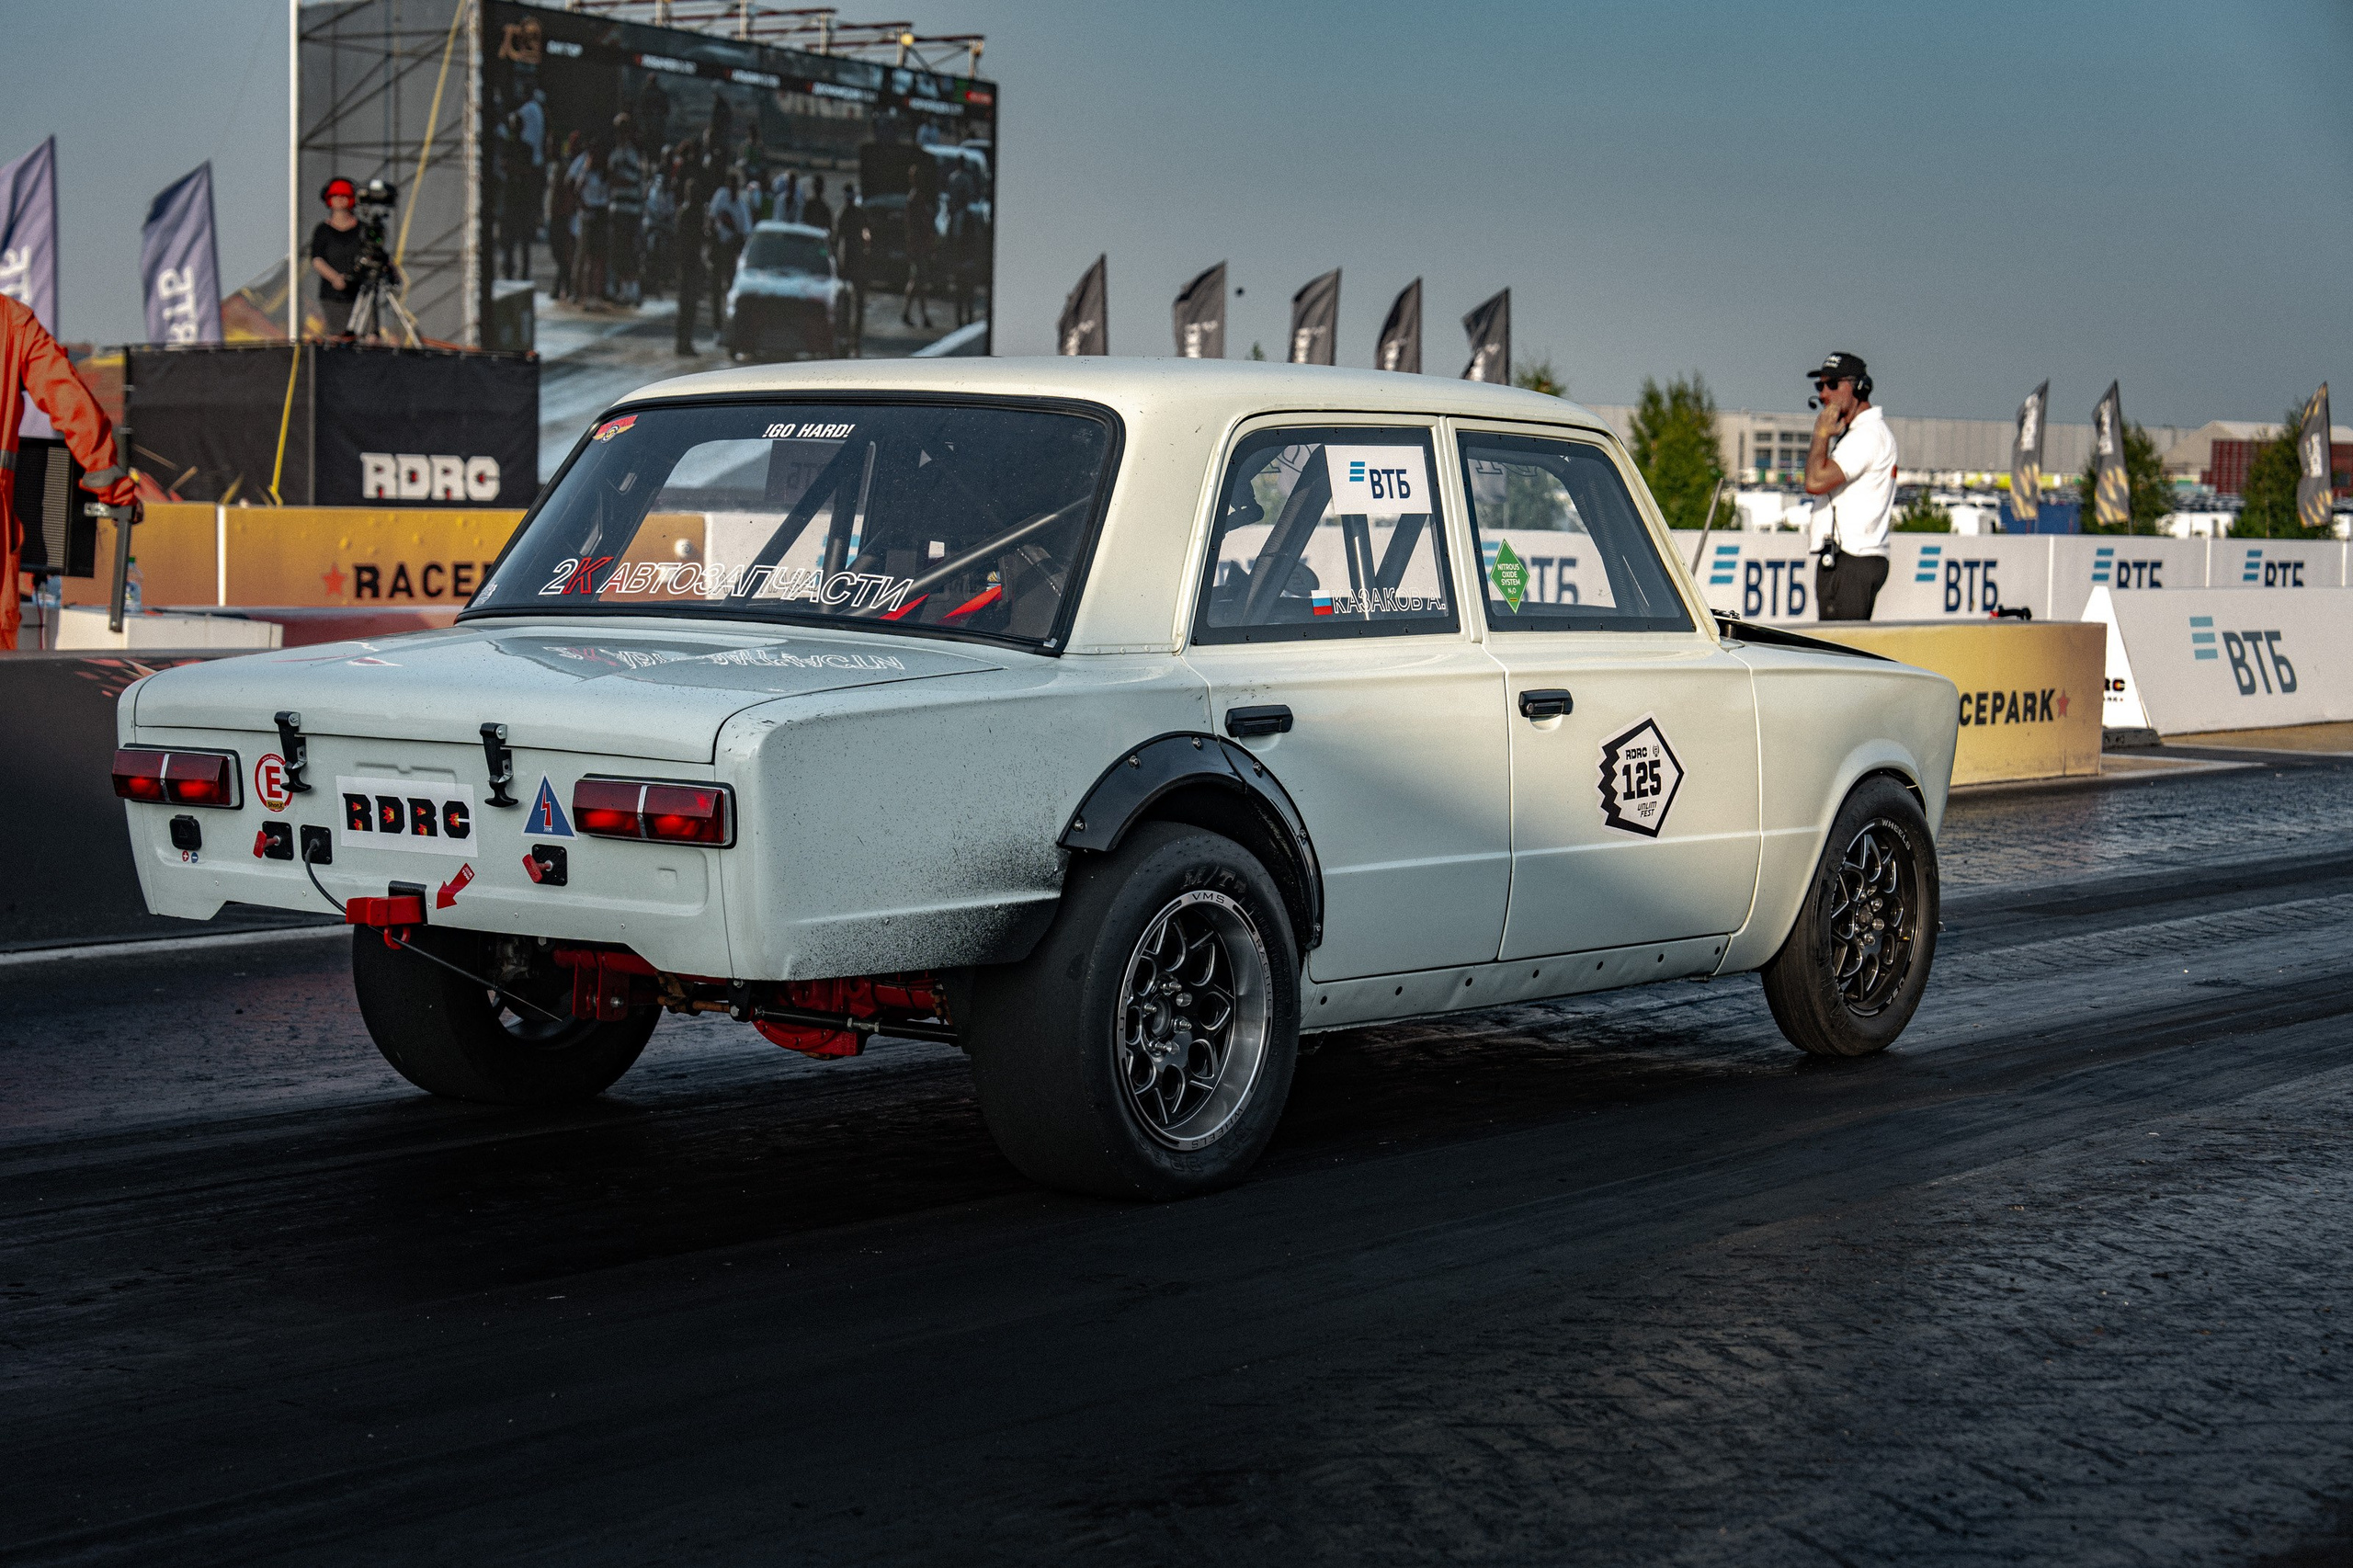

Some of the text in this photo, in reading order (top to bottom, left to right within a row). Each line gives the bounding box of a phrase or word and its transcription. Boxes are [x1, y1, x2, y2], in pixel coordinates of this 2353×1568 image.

[796, 423, 857, 438] HARD!
[359, 451, 501, 502] RDRC
[1368, 468, 1411, 499] ВТБ
[353, 562, 494, 599] RACE
[596, 561, 915, 613] АВТОЗАПЧАСТИ
[1745, 561, 1806, 617] ВТБ
[1945, 560, 1998, 612] ВТБ
[1333, 586, 1447, 614] КАЗАКОВ А.
[2222, 631, 2298, 696] ВТБ
[1625, 746, 1648, 760] RDRC
[265, 766, 283, 799] E
[1621, 759, 1662, 801] 125
[342, 792, 471, 840] RDRC
[1640, 809, 1655, 818] FEST
[1881, 818, 1912, 851] WHEELS
[1191, 892, 1226, 904] VMS
[1885, 976, 1905, 1006] USA
[1191, 1108, 1244, 1149] WHEELS
